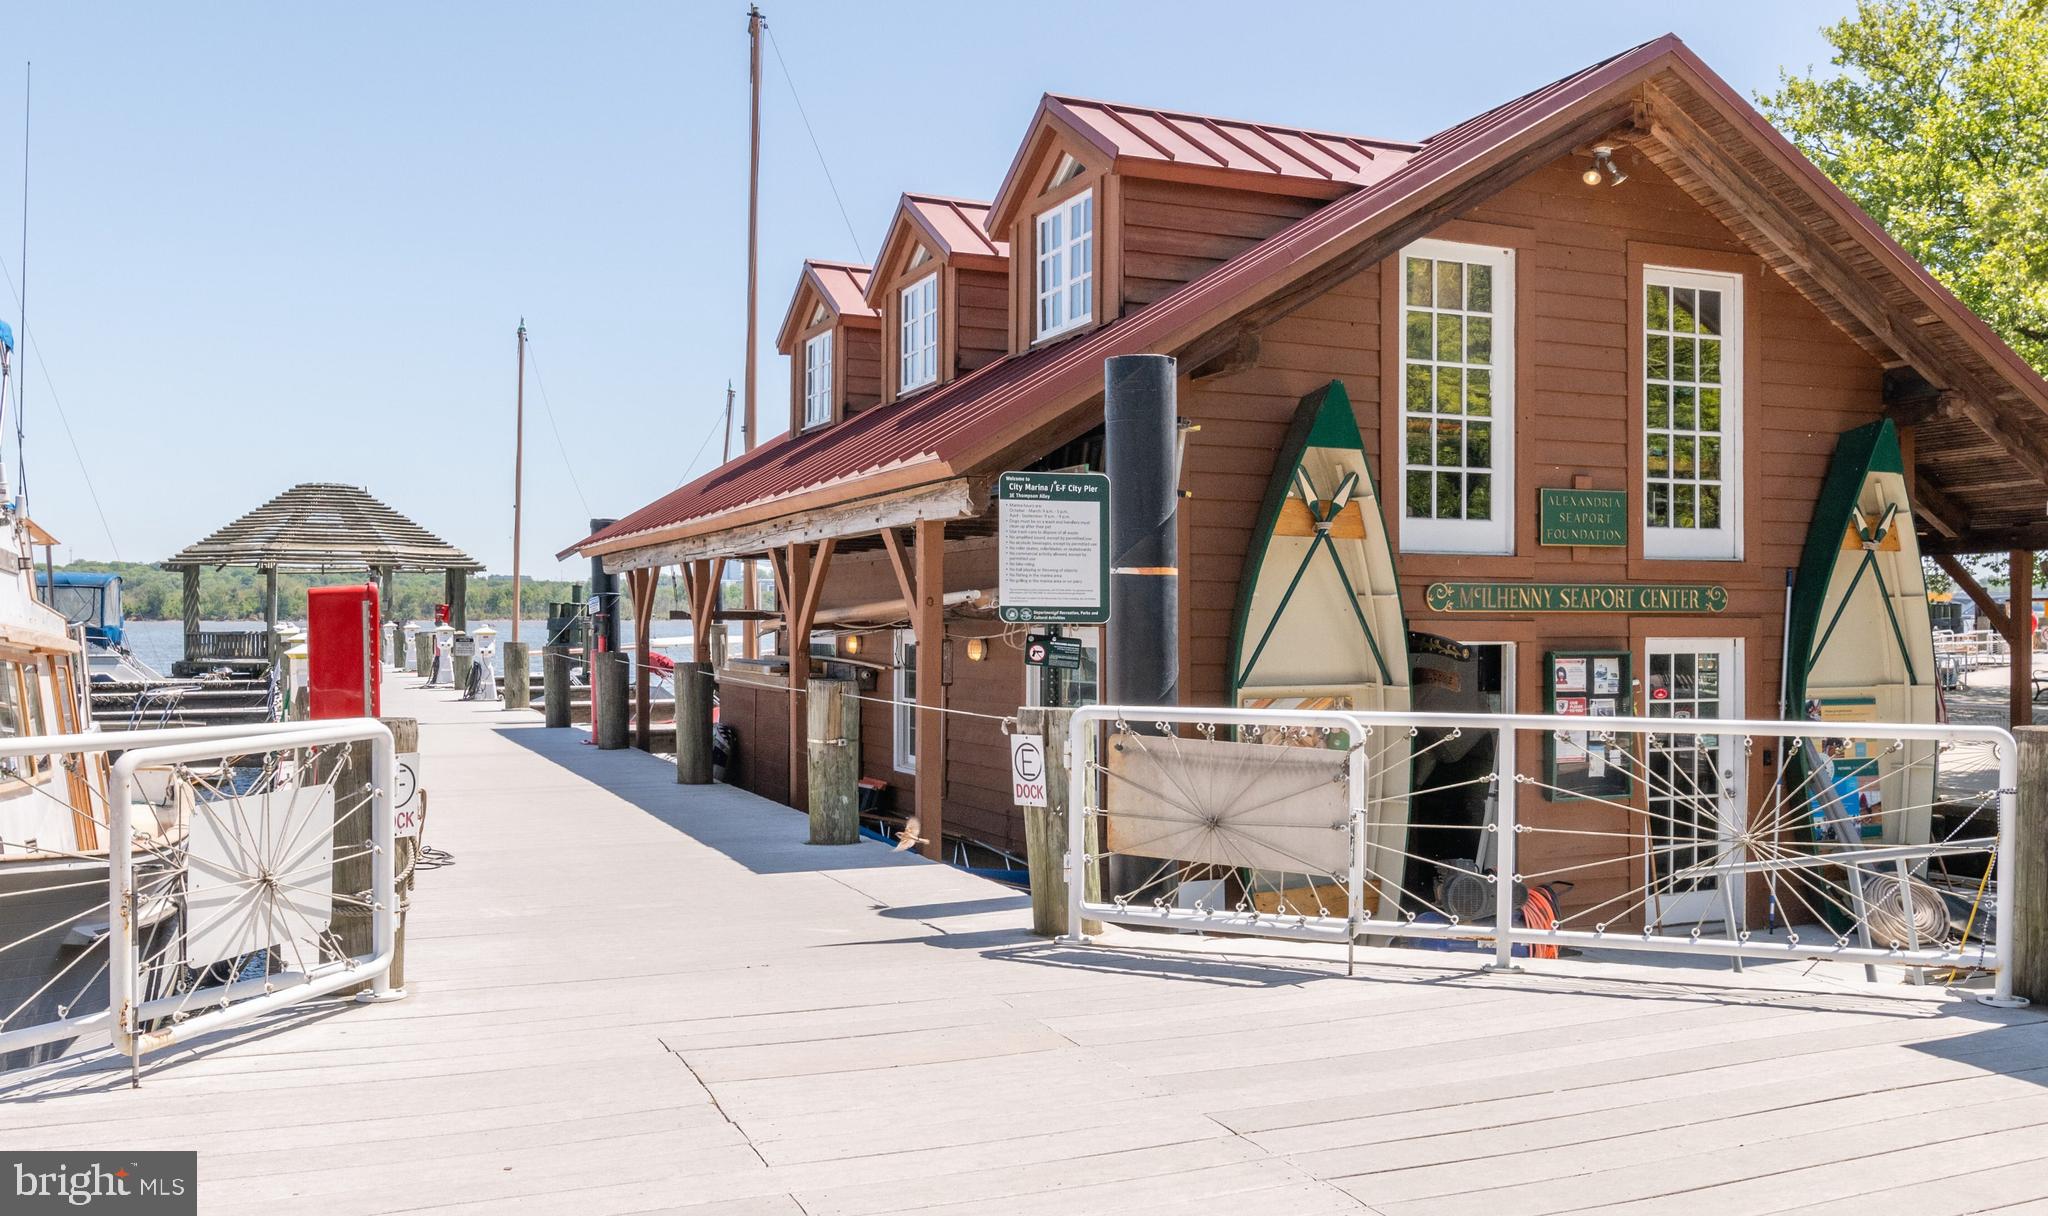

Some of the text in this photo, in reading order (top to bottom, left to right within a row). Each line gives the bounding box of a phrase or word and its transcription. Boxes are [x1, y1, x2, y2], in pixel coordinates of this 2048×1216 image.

[1009, 484, 1022, 492] City
[1547, 496, 1621, 508] ALEXANDRIA
[1559, 513, 1612, 524] SEAPORT
[1547, 529, 1622, 540] FOUNDATION
[1560, 588, 1635, 609] SEAPORT
[1640, 588, 1699, 609] CENTER
[1022, 749, 1035, 776] E
[1016, 784, 1043, 799] DOCK
[395, 811, 414, 829] CK
